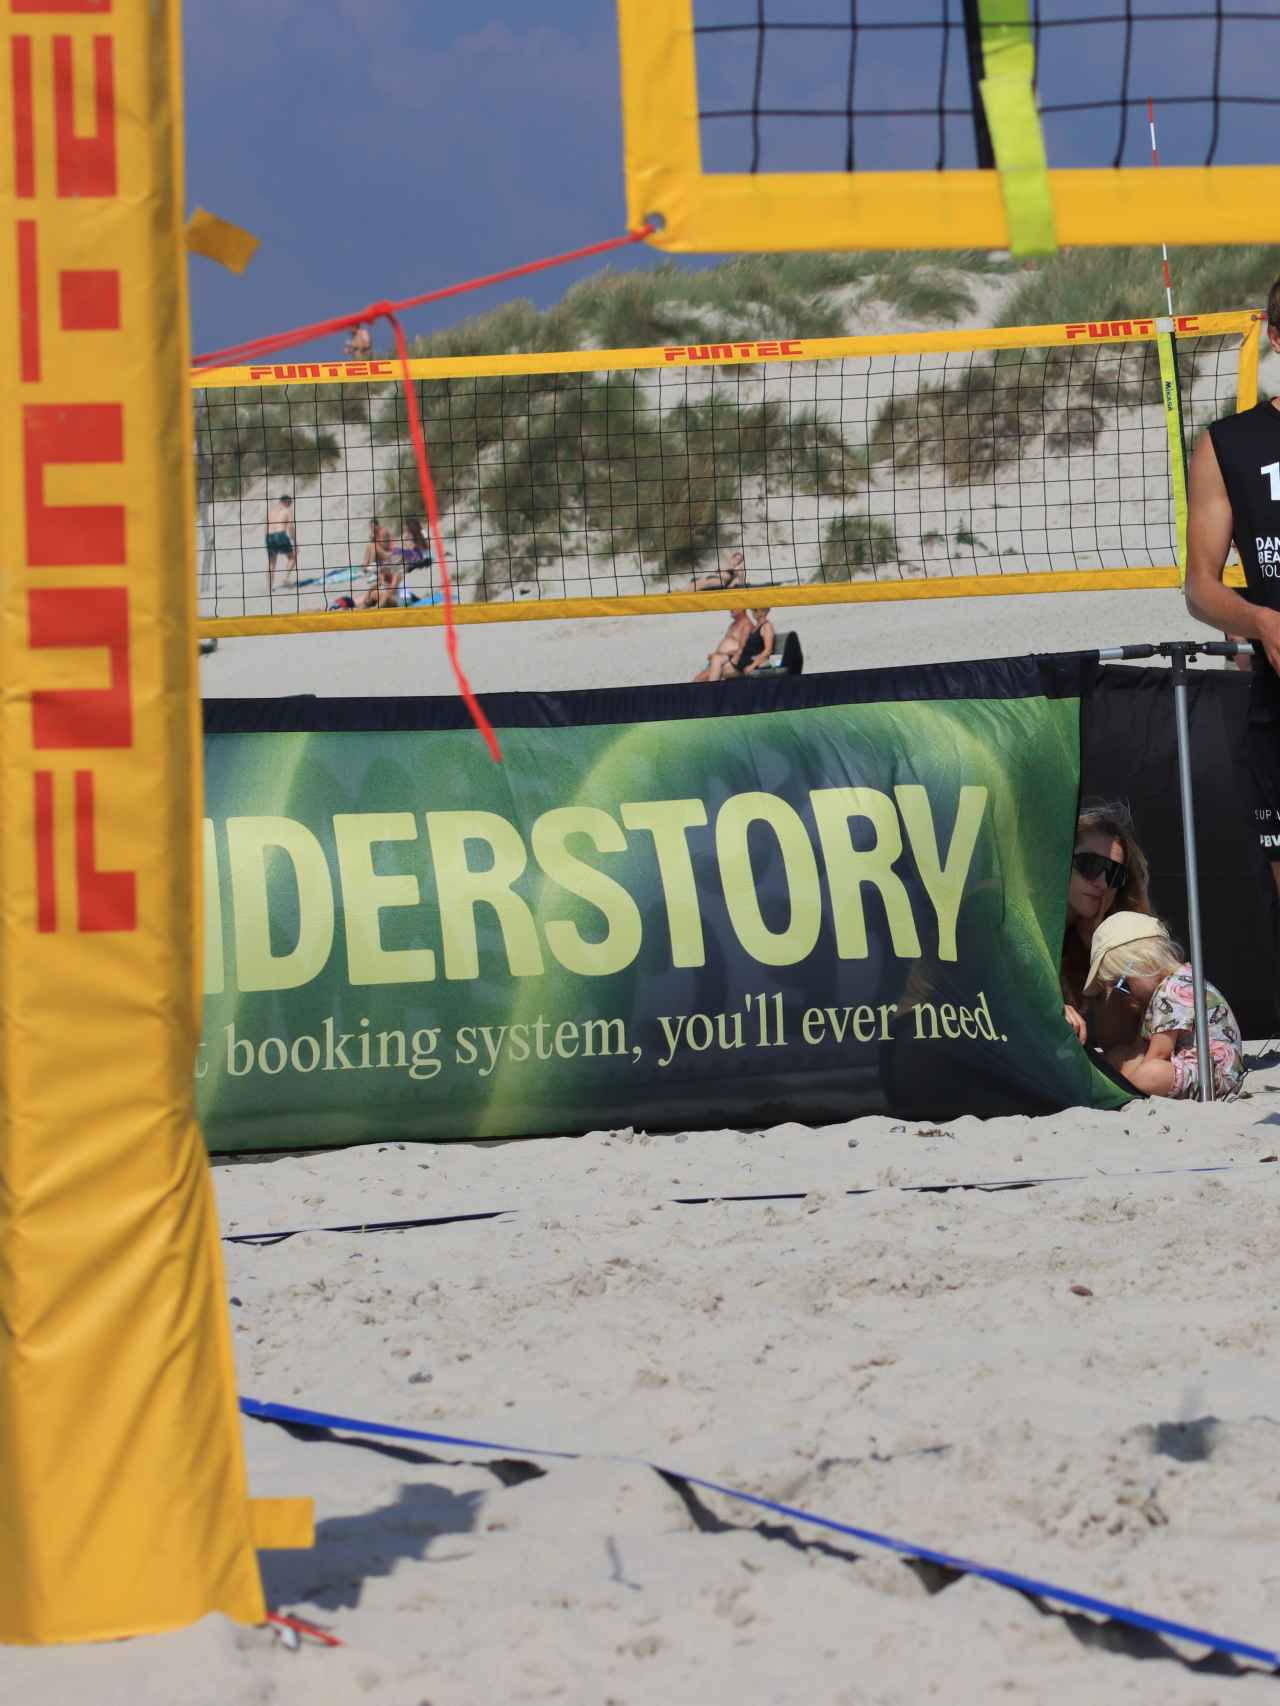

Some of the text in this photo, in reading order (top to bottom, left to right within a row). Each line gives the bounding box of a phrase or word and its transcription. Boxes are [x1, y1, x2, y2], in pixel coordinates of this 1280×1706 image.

[1065, 316, 1200, 340] FUNTC
[665, 340, 804, 361] FUNTEC
[249, 360, 393, 381] FUNTEC
[10, 0, 138, 933] FUNTE
[223, 1016, 442, 1080] booking
[455, 1013, 643, 1077] system,
[657, 991, 789, 1067] you'll
[802, 1002, 899, 1045] ever
[911, 991, 1009, 1042] need.
